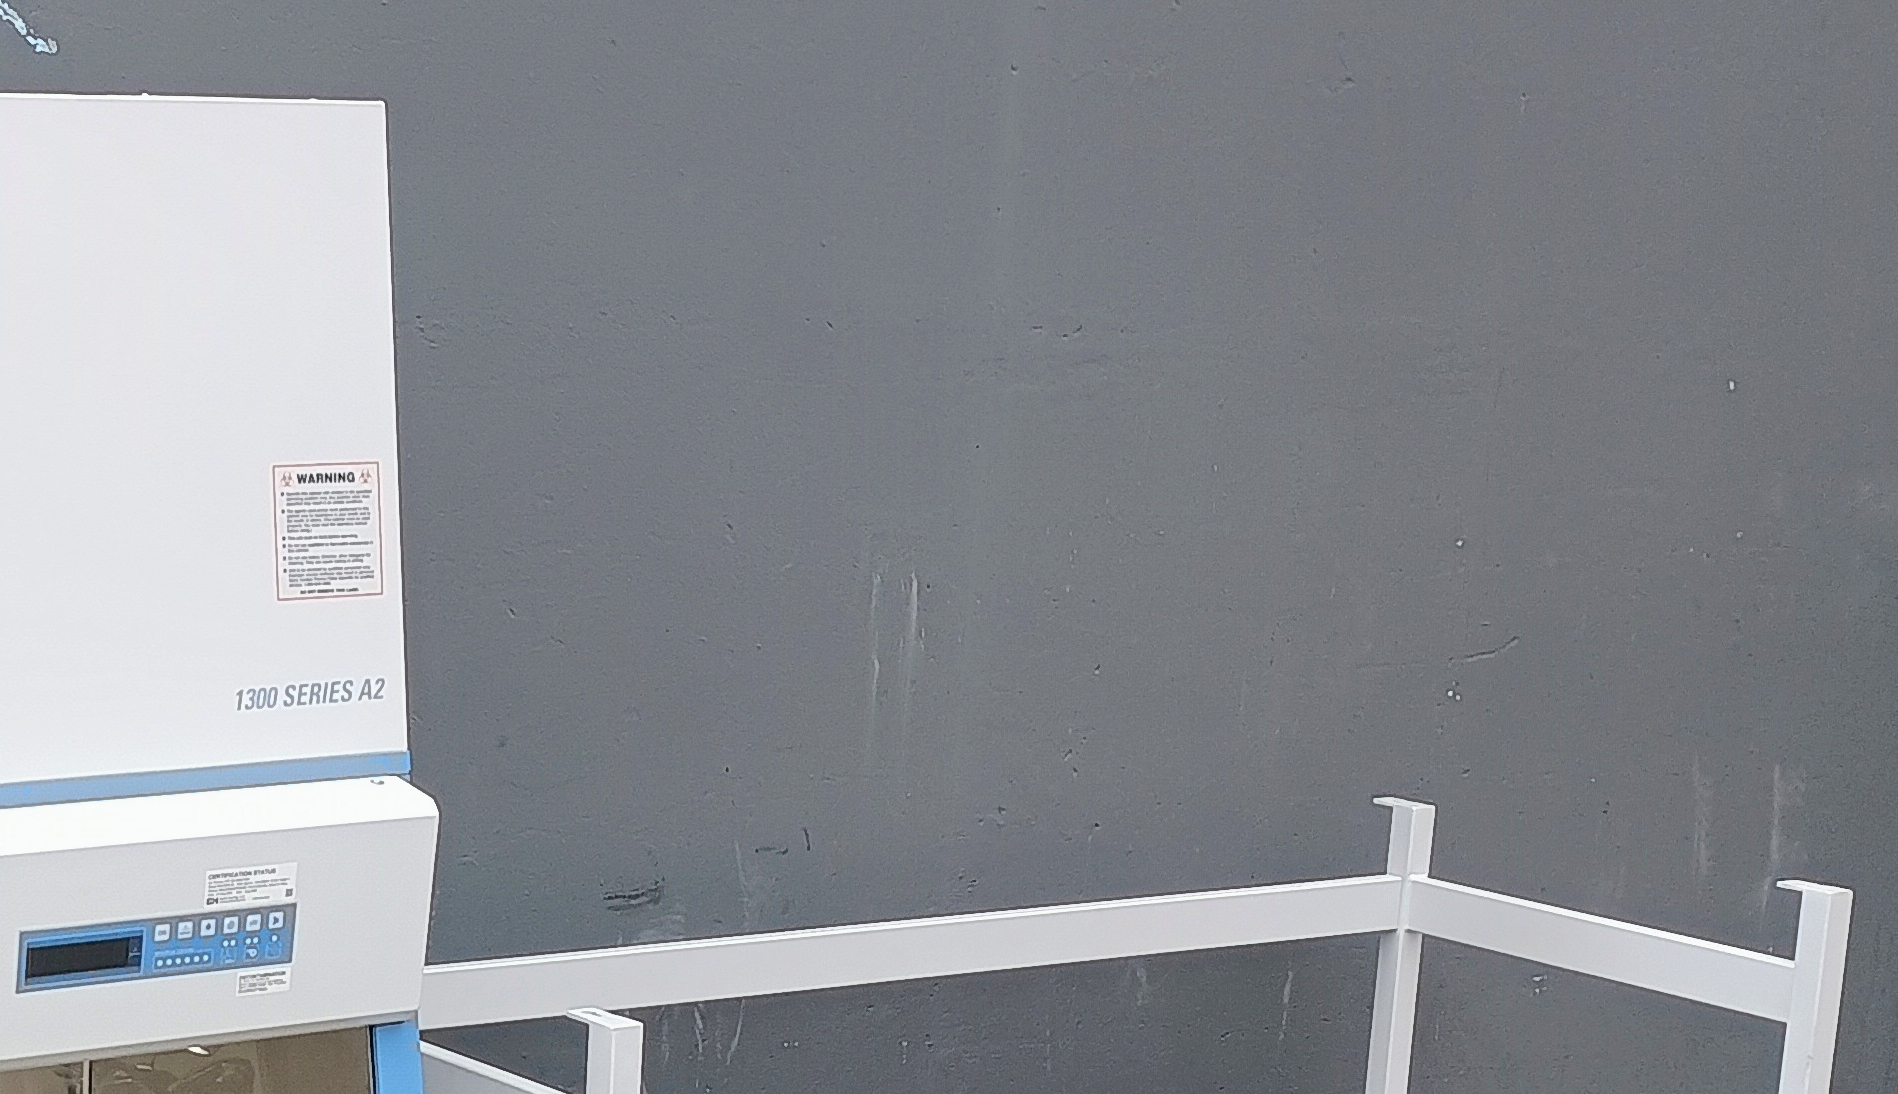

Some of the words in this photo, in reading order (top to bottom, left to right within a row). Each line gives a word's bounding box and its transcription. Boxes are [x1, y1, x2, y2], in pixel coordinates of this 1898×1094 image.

[297, 471, 356, 484] WARNING
[235, 686, 279, 711] 1300
[283, 679, 354, 707] SERIES
[357, 677, 386, 701] A2
